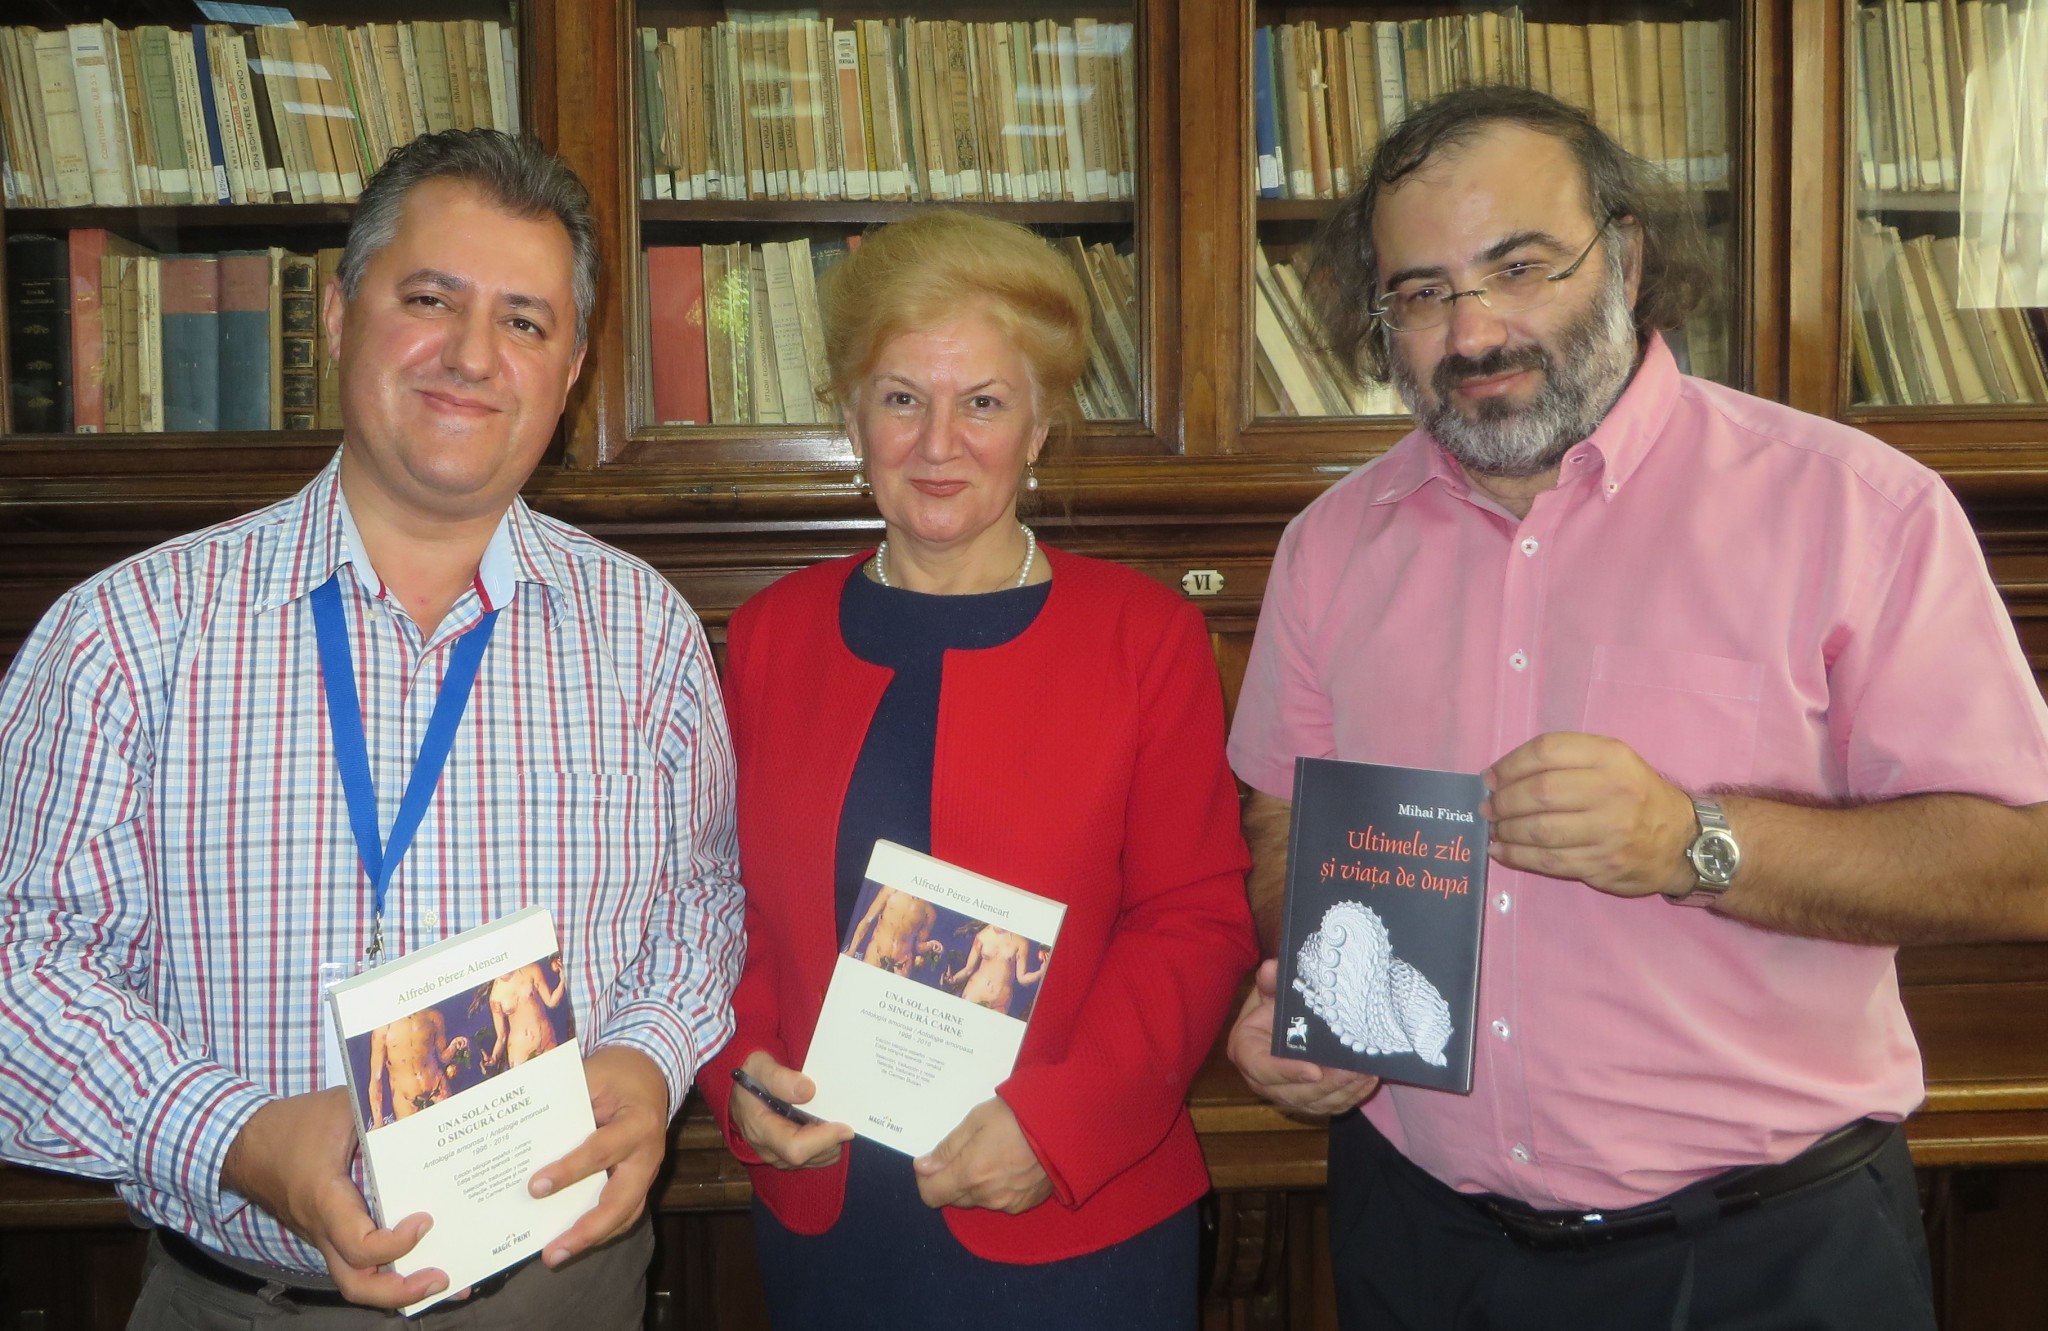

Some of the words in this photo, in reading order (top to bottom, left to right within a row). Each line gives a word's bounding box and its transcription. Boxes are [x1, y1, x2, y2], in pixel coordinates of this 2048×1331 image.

[1192, 574, 1211, 591] VI
[1398, 804, 1434, 819] Mihai
[1437, 808, 1474, 823] Firică
[1348, 825, 1428, 857] Ultimele
[1434, 835, 1471, 862] zile
[911, 875, 944, 894] Alfredo
[946, 887, 971, 904] Pérez
[972, 898, 1010, 919] Alencart
[1396, 866, 1415, 888] de
[1421, 869, 1468, 899] după
[398, 982, 436, 1005] Alfredo
[437, 969, 465, 988] Pérez
[467, 951, 509, 975] Alencart
[879, 1001, 886, 1009] O
[931, 1020, 963, 1037] CARNE
[885, 990, 904, 1004] UNA
[905, 998, 929, 1014] SOLA
[931, 1008, 964, 1026] CARNE
[437, 1138, 446, 1147] O
[497, 1096, 532, 1119] CARNE
[438, 1118, 461, 1133] UNA
[462, 1104, 490, 1122] SOLA
[491, 1086, 526, 1108] CARNE
[868, 1115, 885, 1127] MAGIC
[886, 1122, 903, 1133] PRINT
[492, 1240, 512, 1256] MAGIC
[513, 1230, 531, 1245] PRINT
